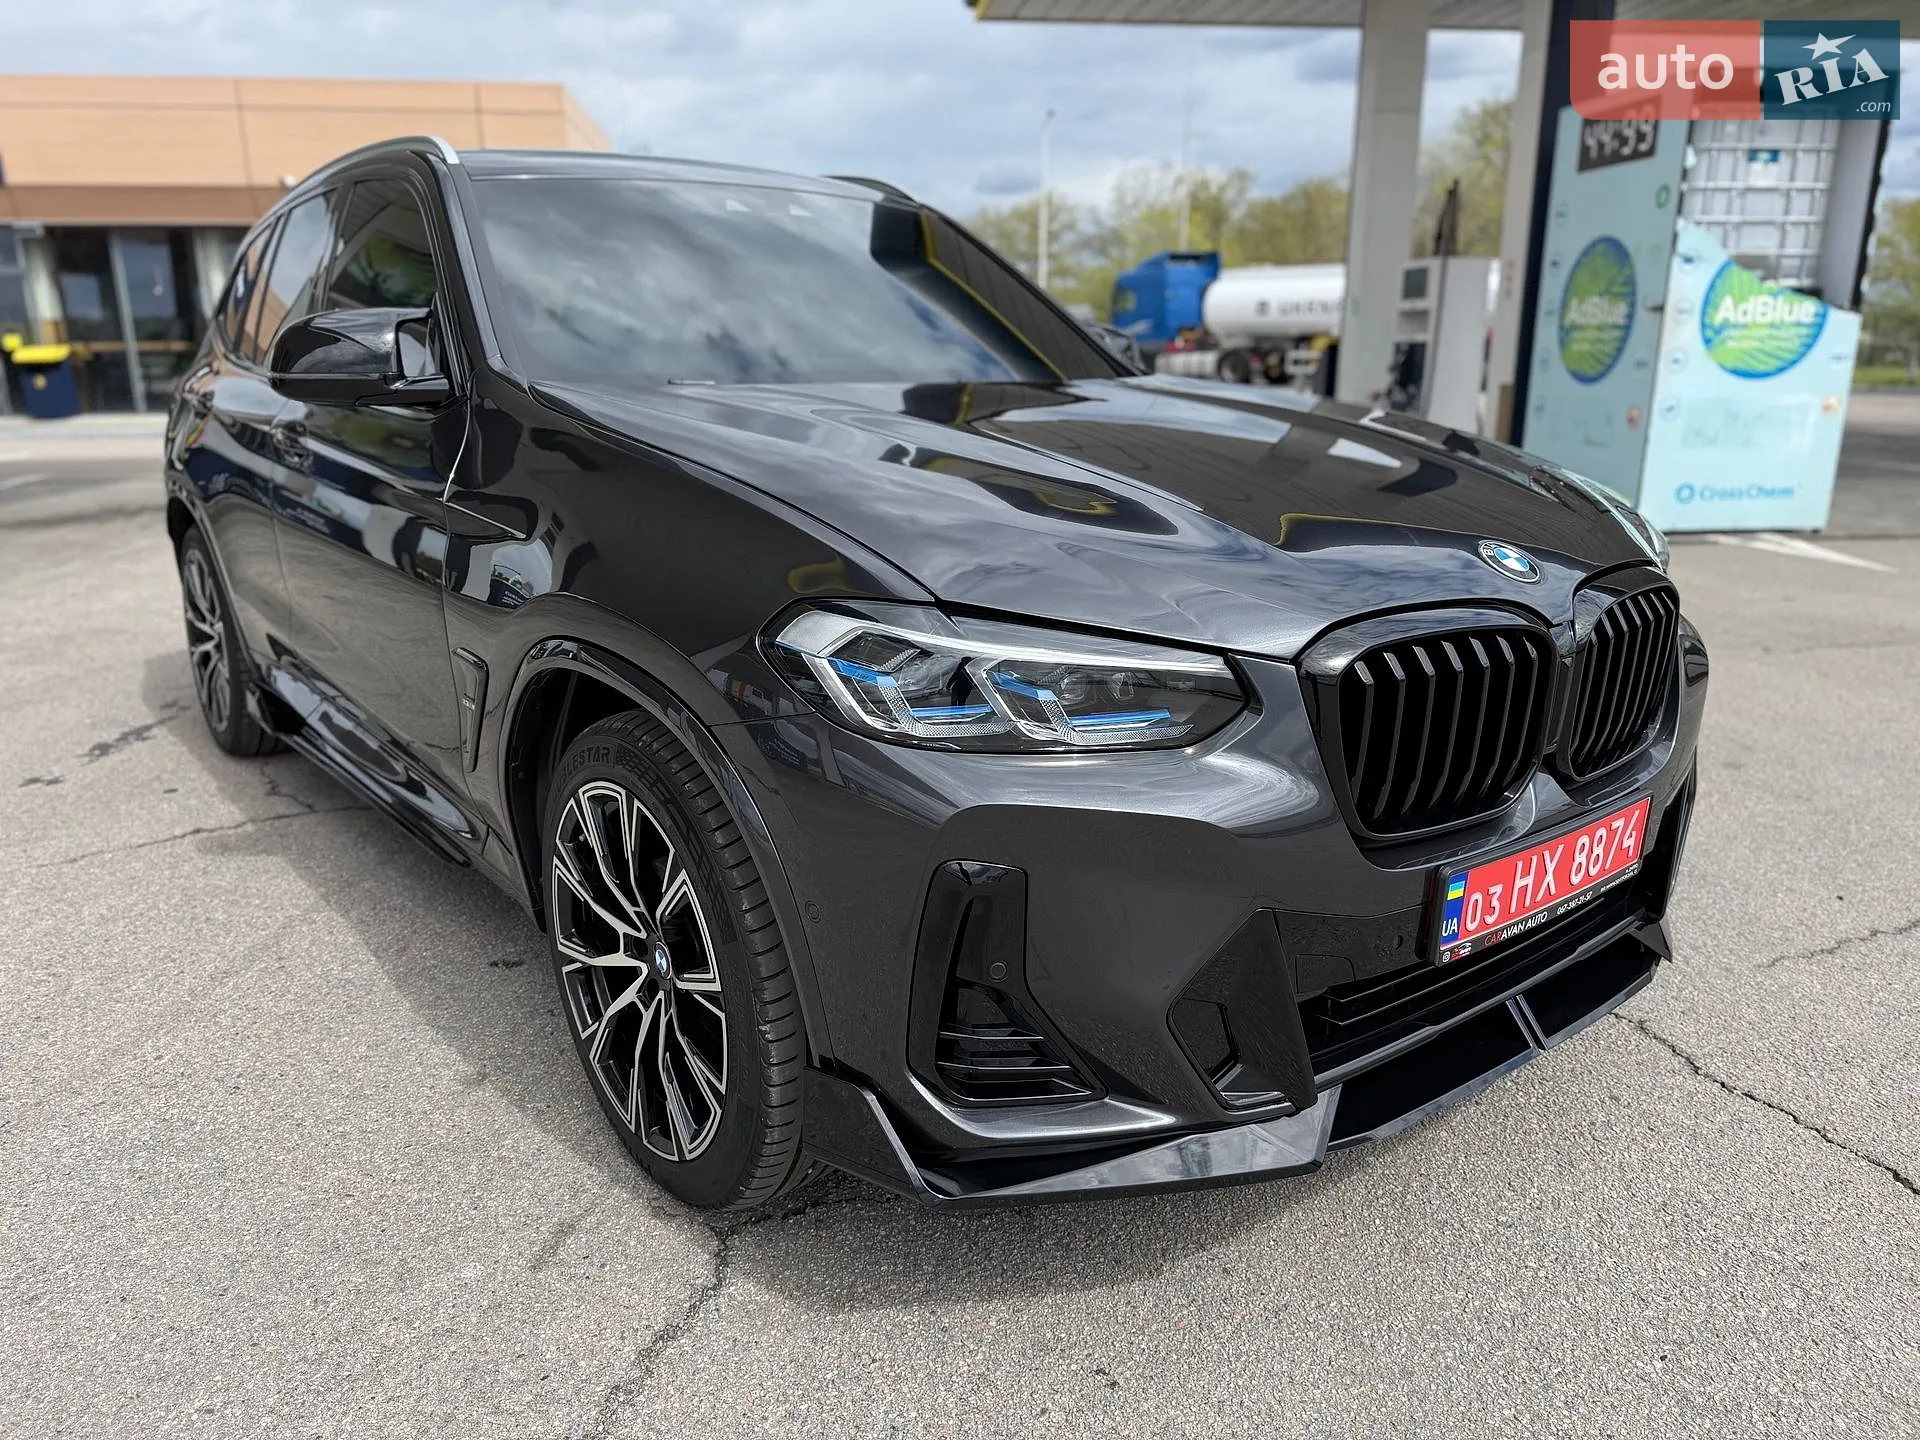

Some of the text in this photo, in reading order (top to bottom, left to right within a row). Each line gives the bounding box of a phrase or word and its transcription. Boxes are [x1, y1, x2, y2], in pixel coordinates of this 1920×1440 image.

[1565, 294, 1628, 326] AdBlue
[1714, 293, 1815, 325] AdBlue
[1442, 917, 1458, 936] UA
[1465, 883, 1503, 932] 03
[1509, 844, 1565, 914] HX
[1569, 809, 1640, 886] 8874
[1484, 921, 1526, 946] CARAVAN
[1525, 911, 1548, 930] AUTO
